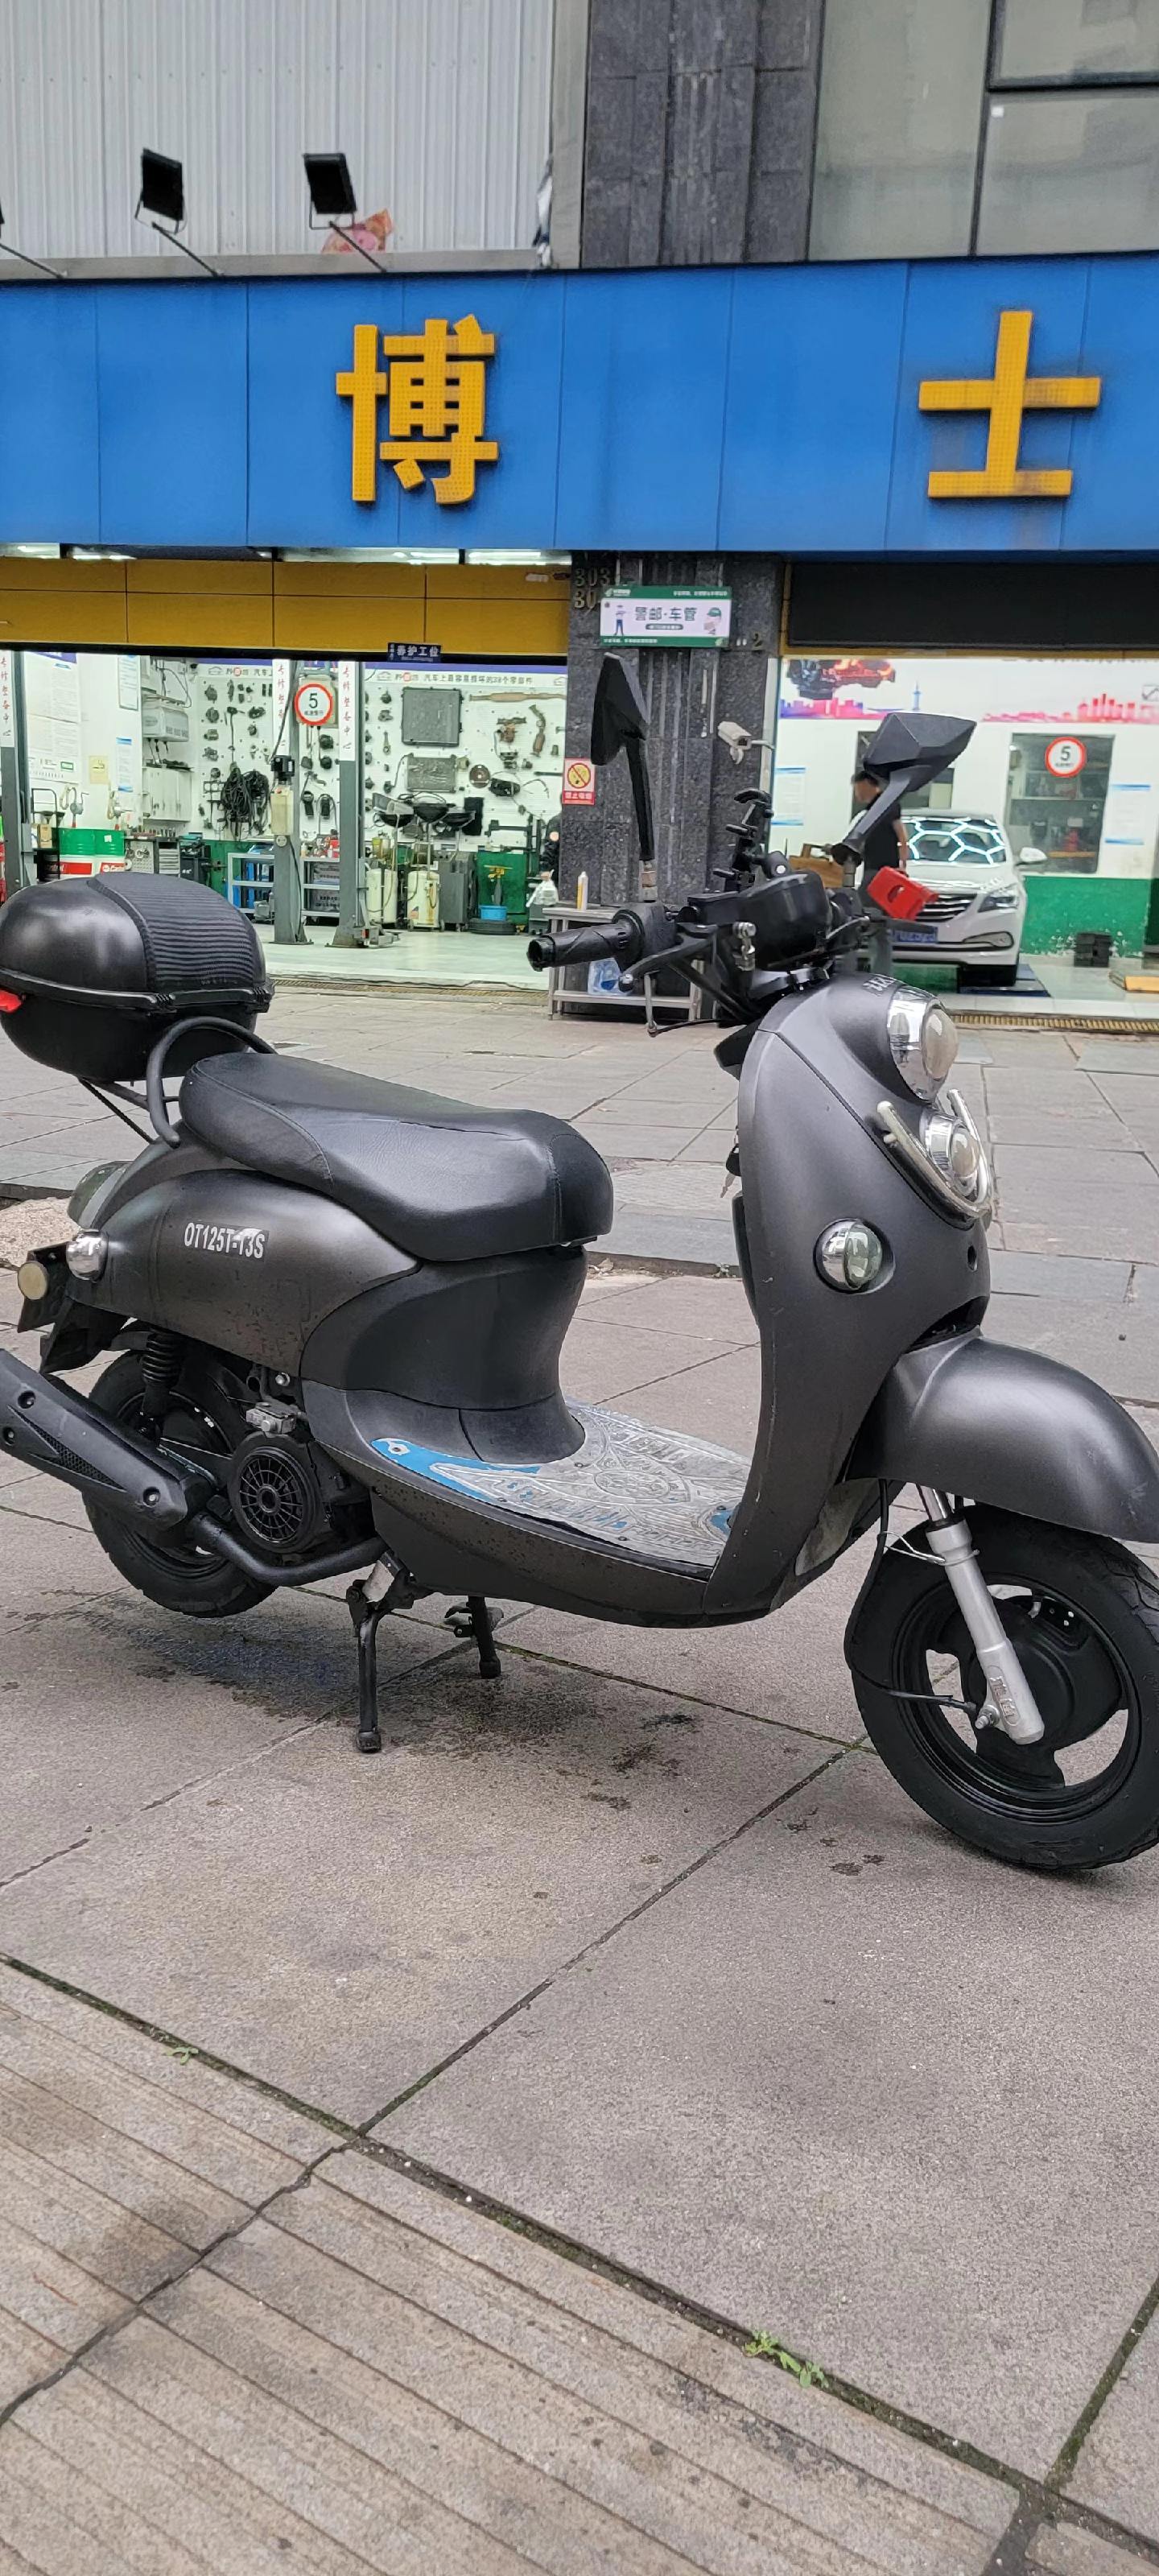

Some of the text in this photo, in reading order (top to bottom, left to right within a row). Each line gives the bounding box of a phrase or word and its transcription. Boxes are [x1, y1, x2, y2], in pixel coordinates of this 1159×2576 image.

[336, 311, 1102, 505] 博 士
[574, 588, 600, 609] 30
[308, 692, 318, 708] 5
[1060, 745, 1071, 761] 5
